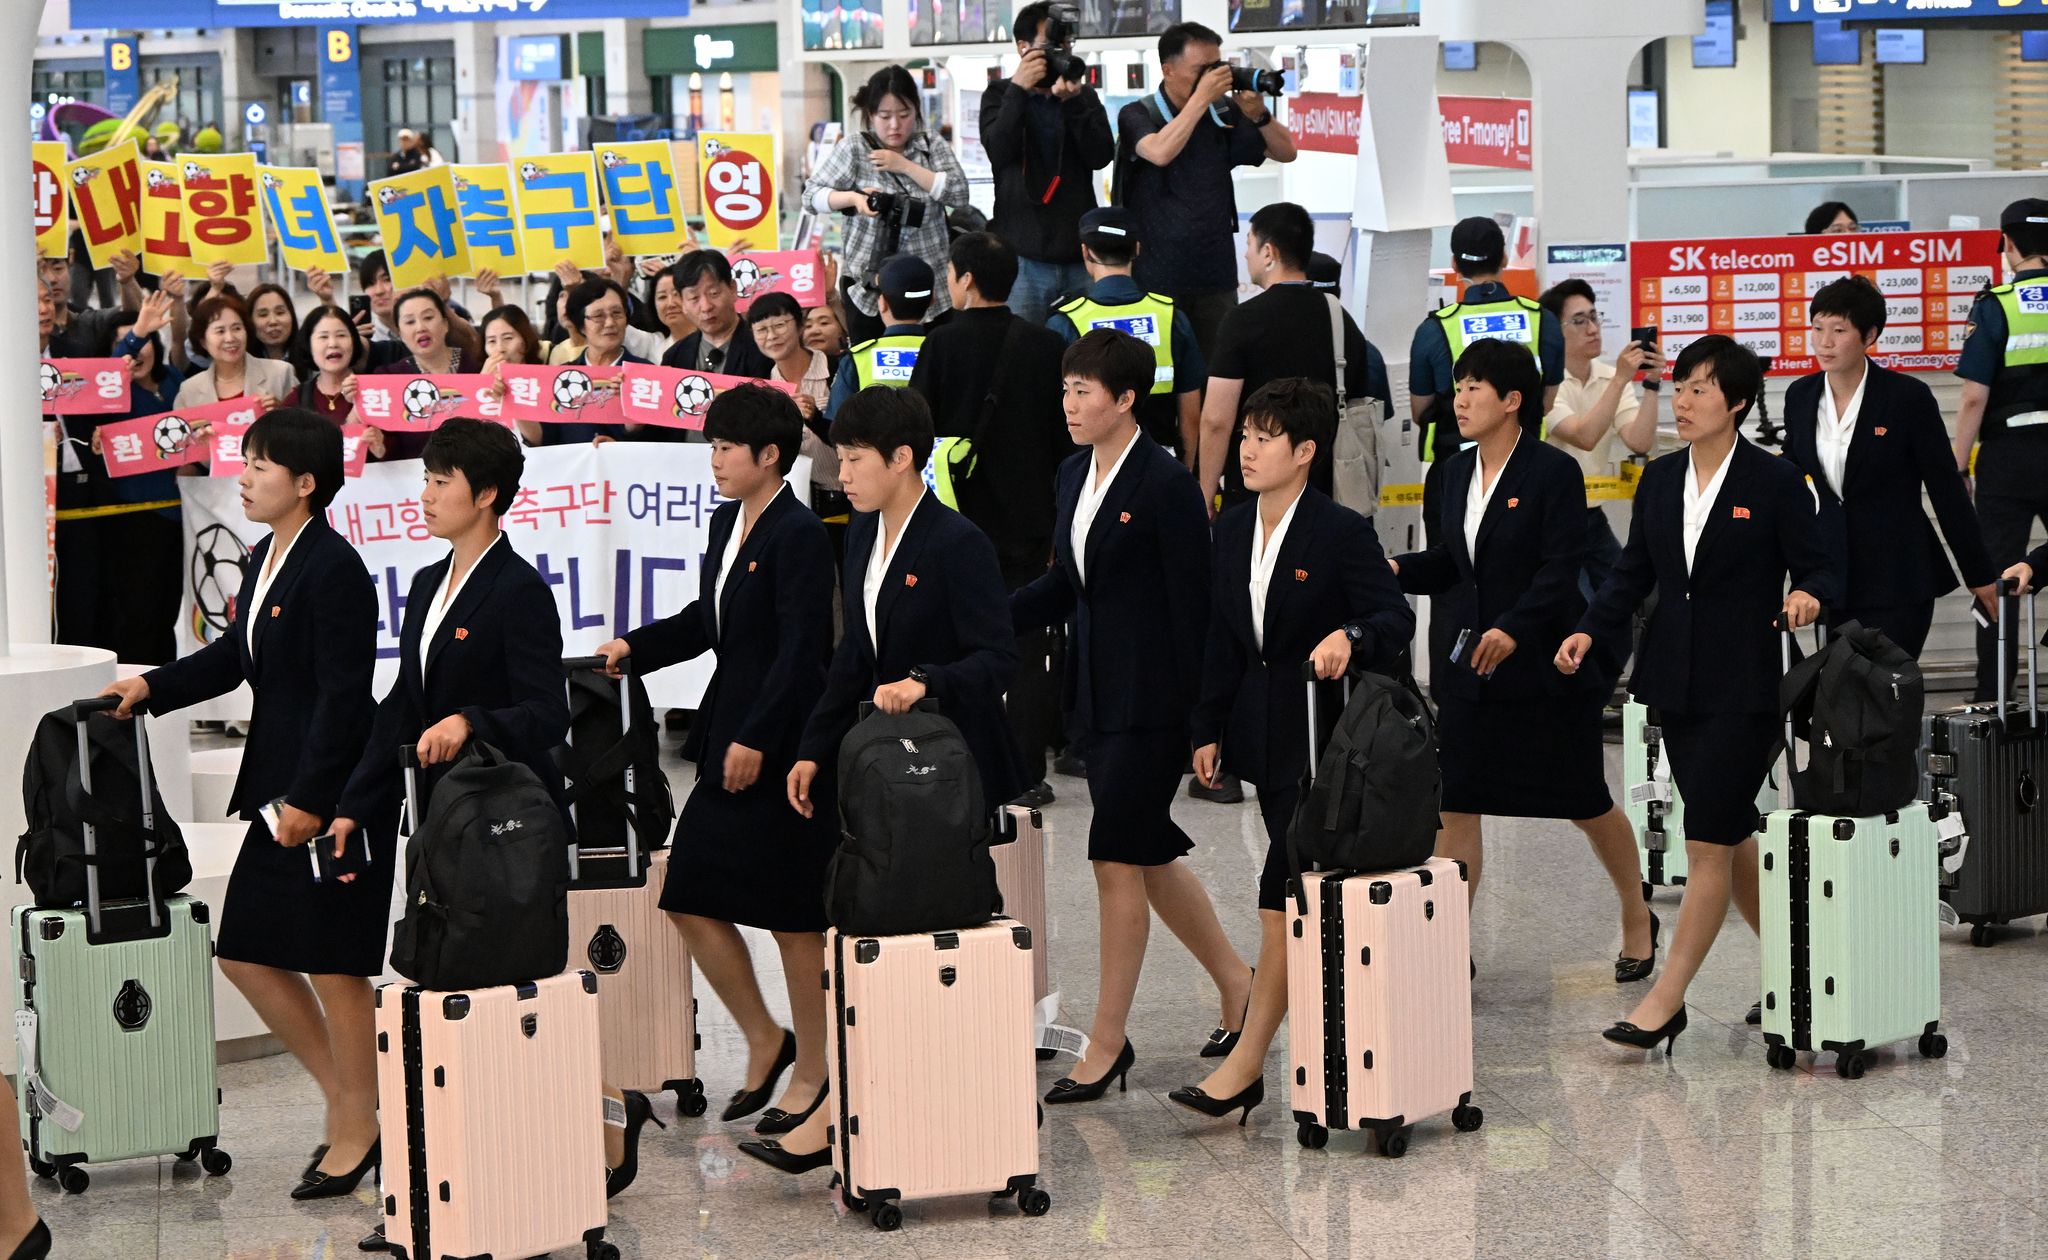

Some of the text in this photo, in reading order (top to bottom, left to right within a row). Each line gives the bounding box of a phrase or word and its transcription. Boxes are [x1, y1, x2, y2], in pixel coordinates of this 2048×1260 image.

[111, 43, 132, 70] B
[327, 30, 351, 62] B
[1288, 108, 1304, 139] Buy
[1463, 115, 1515, 156] T-money!
[75, 158, 141, 246] 내
[604, 161, 675, 235] 단
[708, 161, 763, 220] 영
[185, 174, 256, 246] 향
[265, 185, 338, 253] 녀
[383, 185, 457, 267] 자
[457, 184, 515, 256] 축
[525, 172, 595, 249] 구
[1669, 239, 1962, 271] SK telecom eSIM SIM
[789, 263, 814, 292] 영
[1779, 358, 1813, 369] Here!
[1889, 354, 1943, 368] T-money
[95, 371, 123, 398] 영
[510, 377, 541, 406] 환
[630, 377, 663, 408] 환
[361, 389, 392, 417] 환
[110, 433, 143, 463] 환
